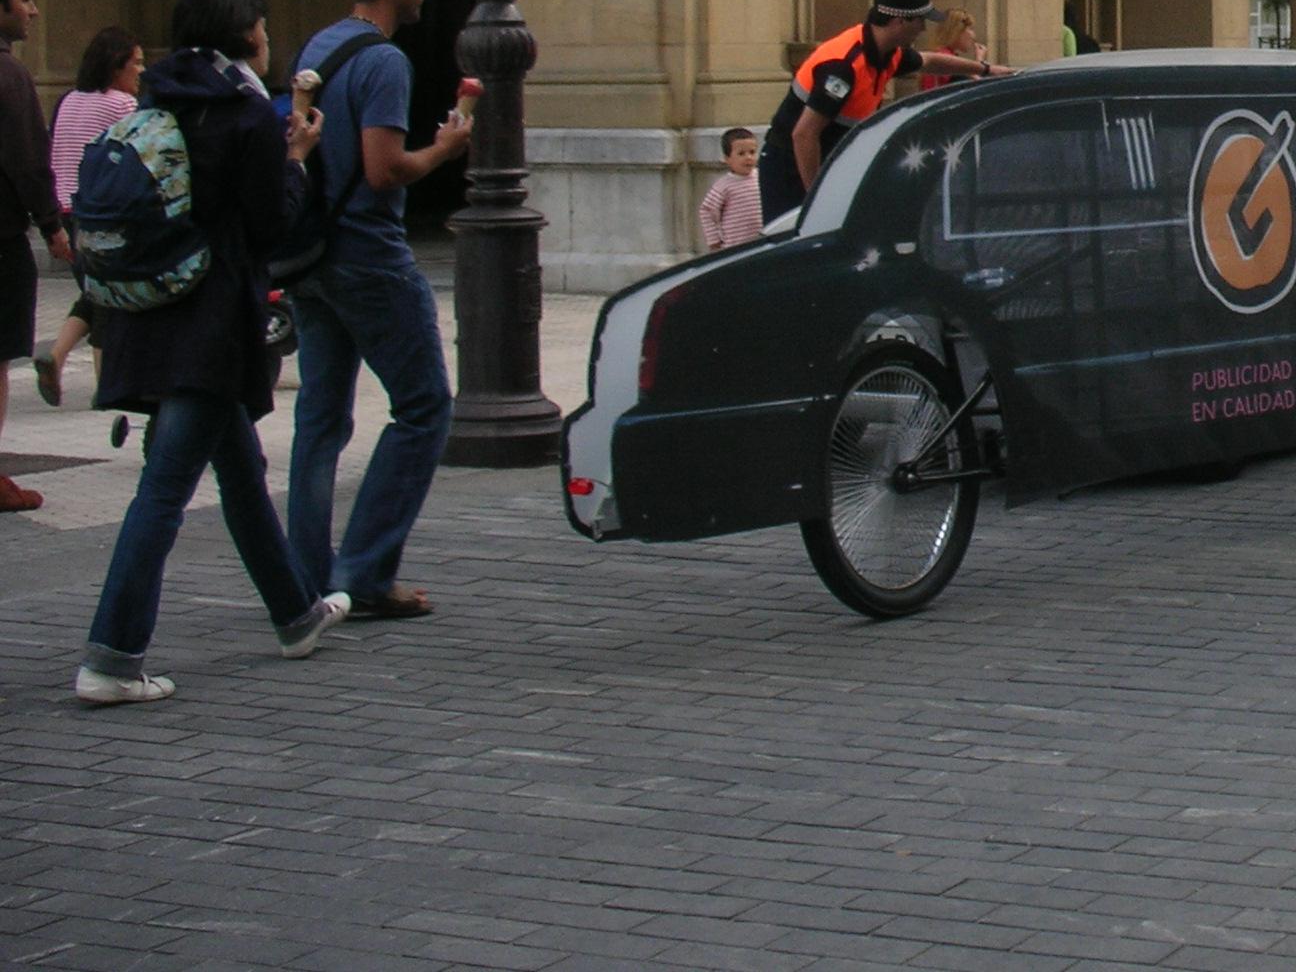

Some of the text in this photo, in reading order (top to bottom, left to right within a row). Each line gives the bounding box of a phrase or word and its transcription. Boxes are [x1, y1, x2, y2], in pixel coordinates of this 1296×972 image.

[1191, 359, 1293, 393] PUBLICIDAD
[1191, 400, 1217, 423] EN
[1222, 389, 1296, 419] CALIDAD
